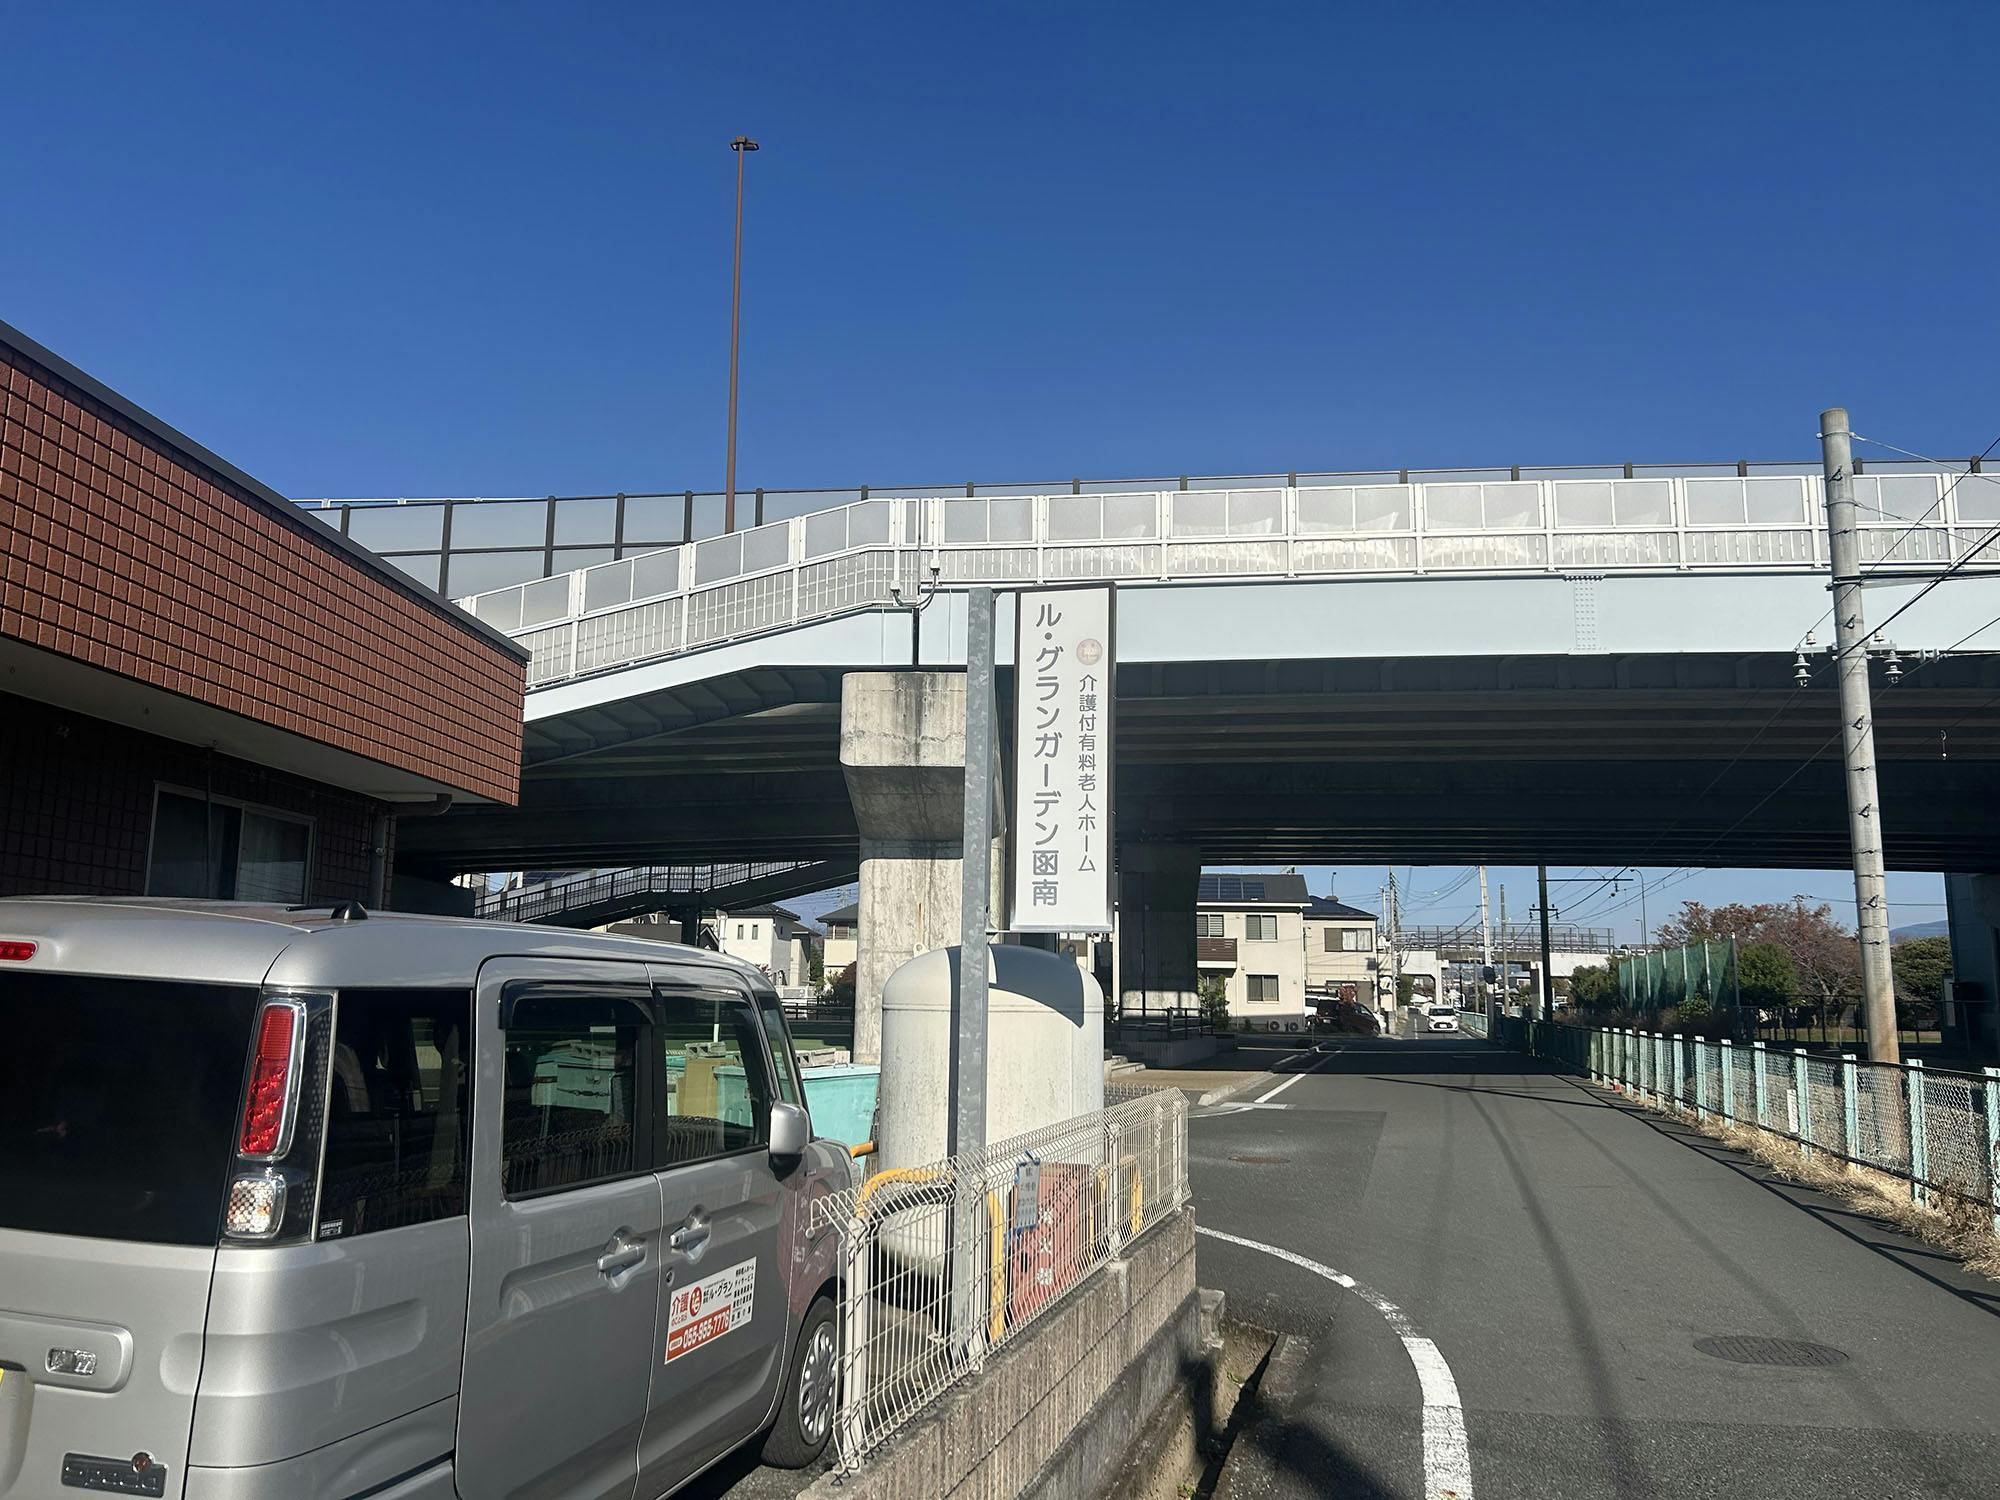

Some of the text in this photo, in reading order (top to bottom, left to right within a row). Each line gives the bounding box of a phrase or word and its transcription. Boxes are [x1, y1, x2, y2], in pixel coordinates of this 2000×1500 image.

[1032, 603, 1064, 906] ル・グランガーデン函南
[1077, 674, 1098, 873] 介護付有料老人ホーム
